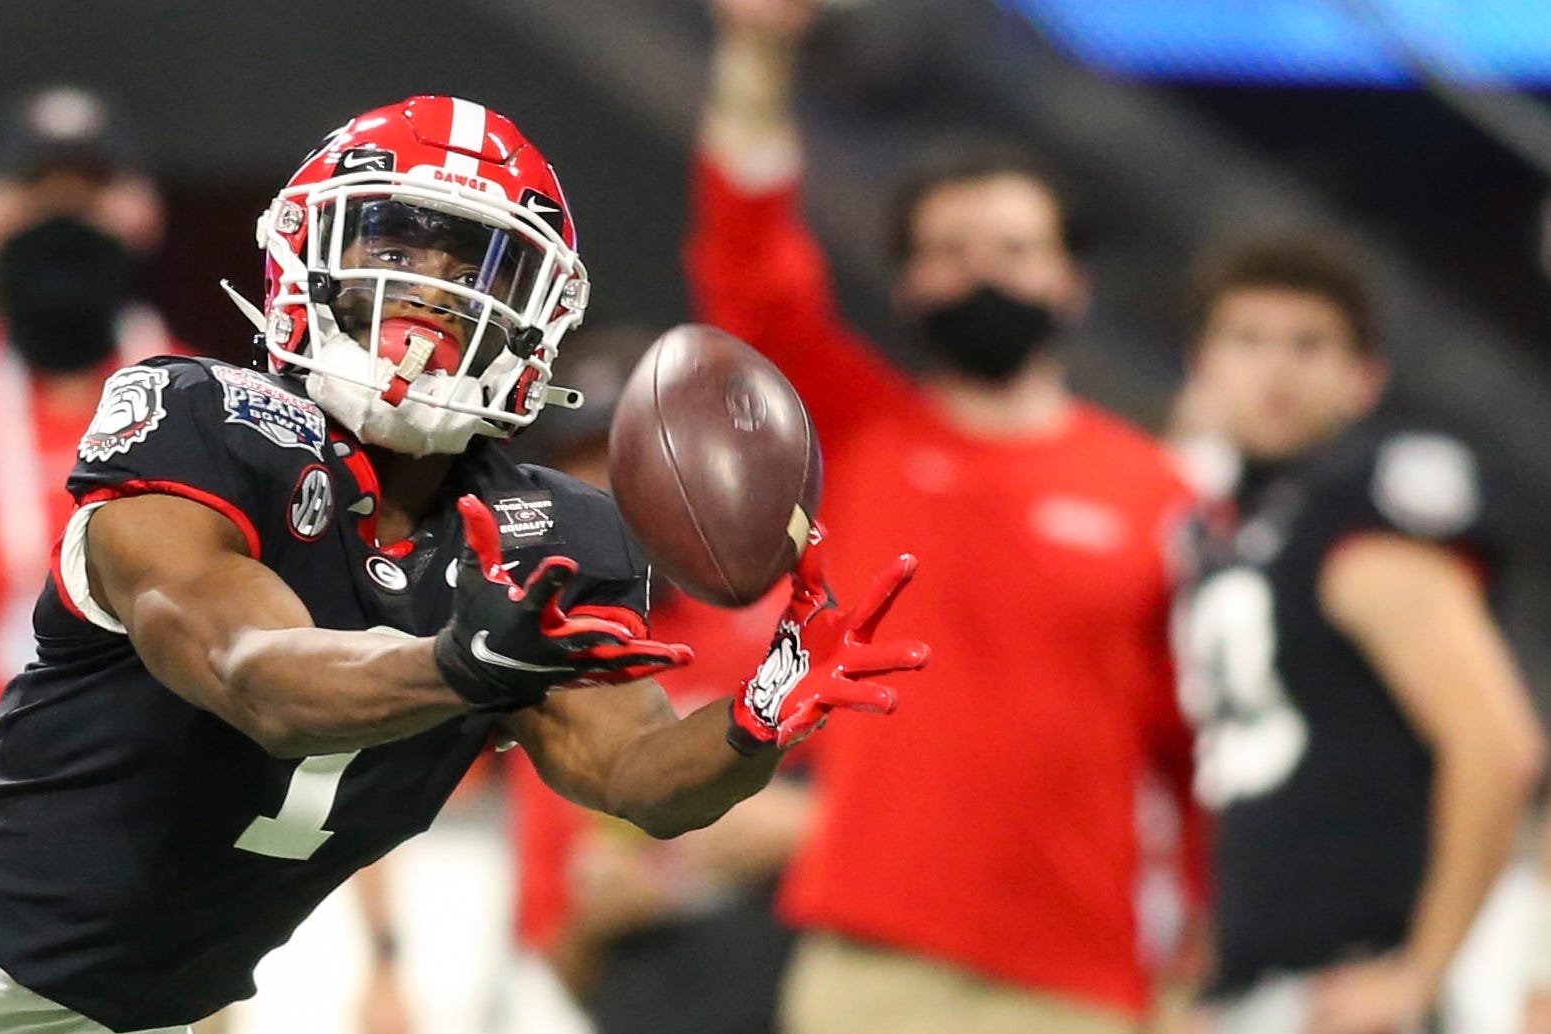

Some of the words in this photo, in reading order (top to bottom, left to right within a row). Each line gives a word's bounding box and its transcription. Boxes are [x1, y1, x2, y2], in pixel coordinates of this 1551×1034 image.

[434, 170, 487, 192] DAWGS
[229, 386, 324, 440] PEACH
[249, 410, 307, 435] BOWL
[493, 500, 553, 512] TOGETHER
[499, 520, 555, 534] EQUALITY
